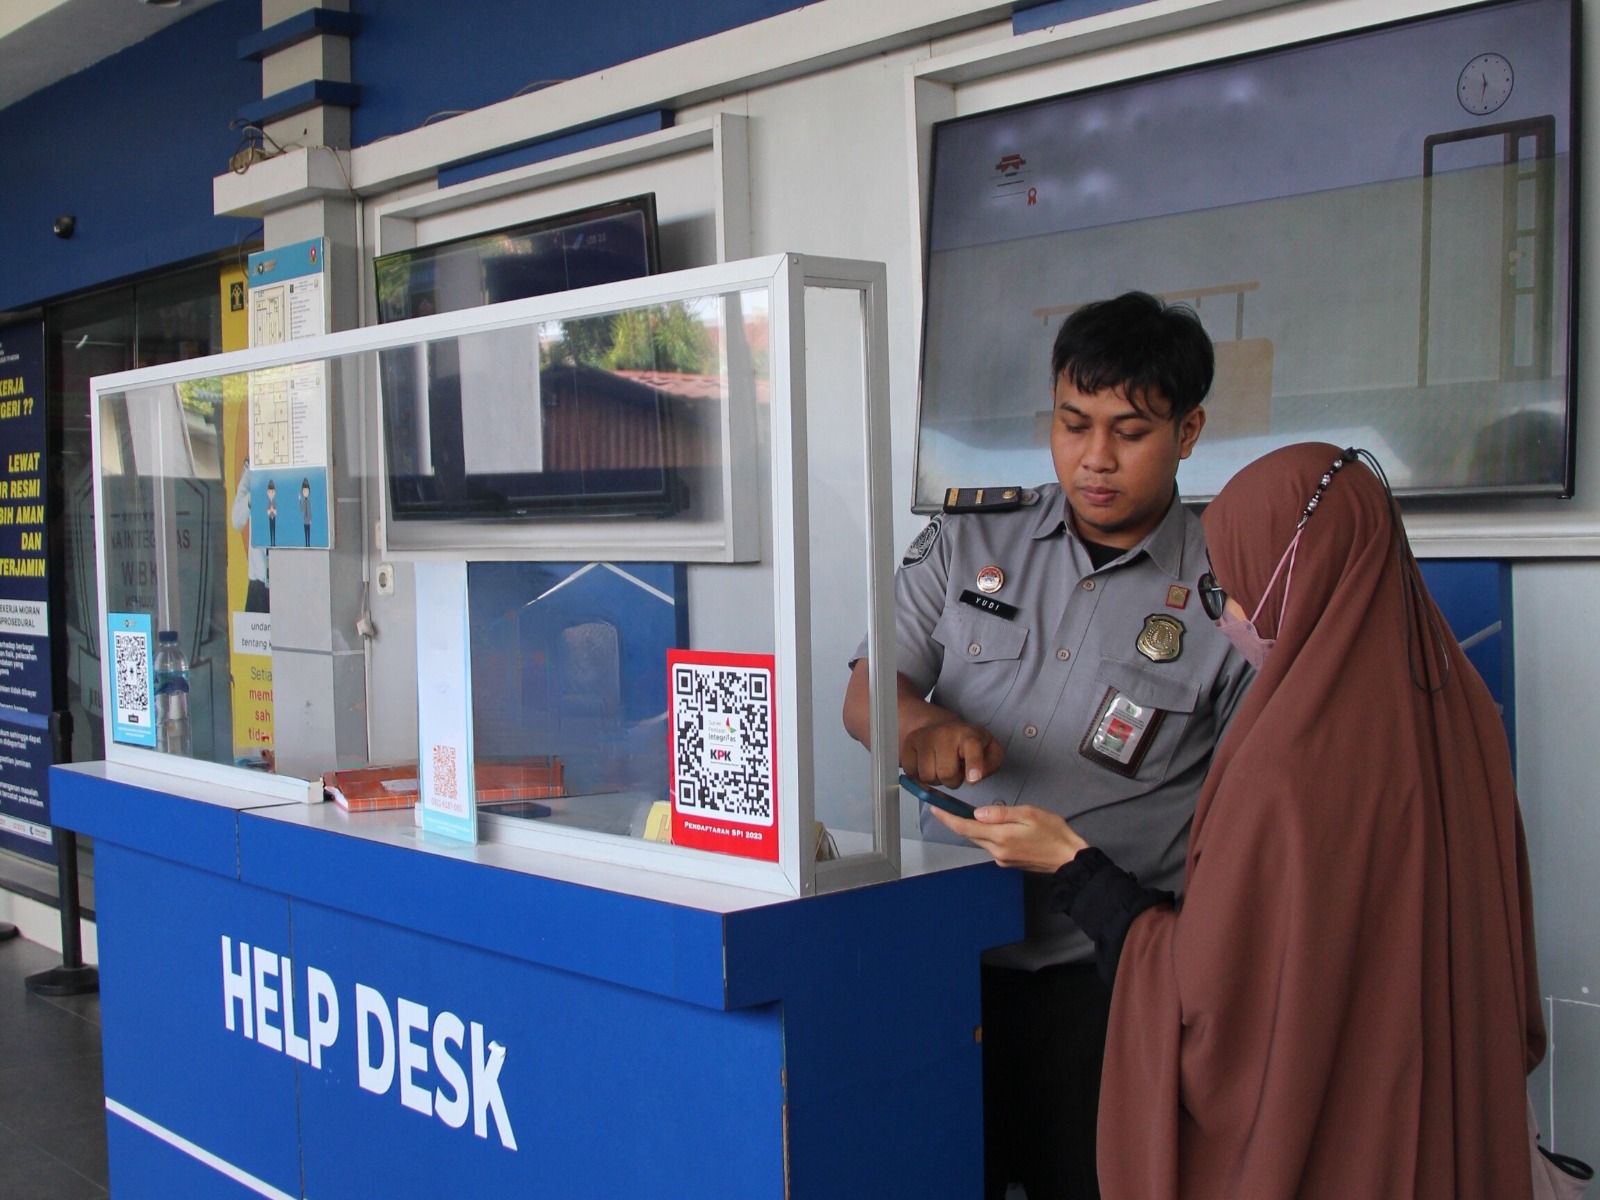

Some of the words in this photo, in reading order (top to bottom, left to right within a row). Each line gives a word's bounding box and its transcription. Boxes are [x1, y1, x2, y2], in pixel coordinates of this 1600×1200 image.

[0, 400, 20, 418] GERI
[8, 452, 40, 473] LEWAT
[10, 479, 40, 498] RESMI
[16, 505, 44, 525] AMAN
[21, 532, 42, 551] DAN
[975, 596, 1000, 611] YUDI
[241, 637, 267, 651] tentang
[255, 708, 270, 721] sah
[708, 733, 736, 742] Integritas
[710, 749, 731, 762] KPK
[684, 821, 730, 836] PENDAFTARAN
[731, 829, 744, 838] SPI
[745, 831, 763, 840] 2023
[221, 935, 340, 1070] HELP
[355, 982, 518, 1151] DESK
